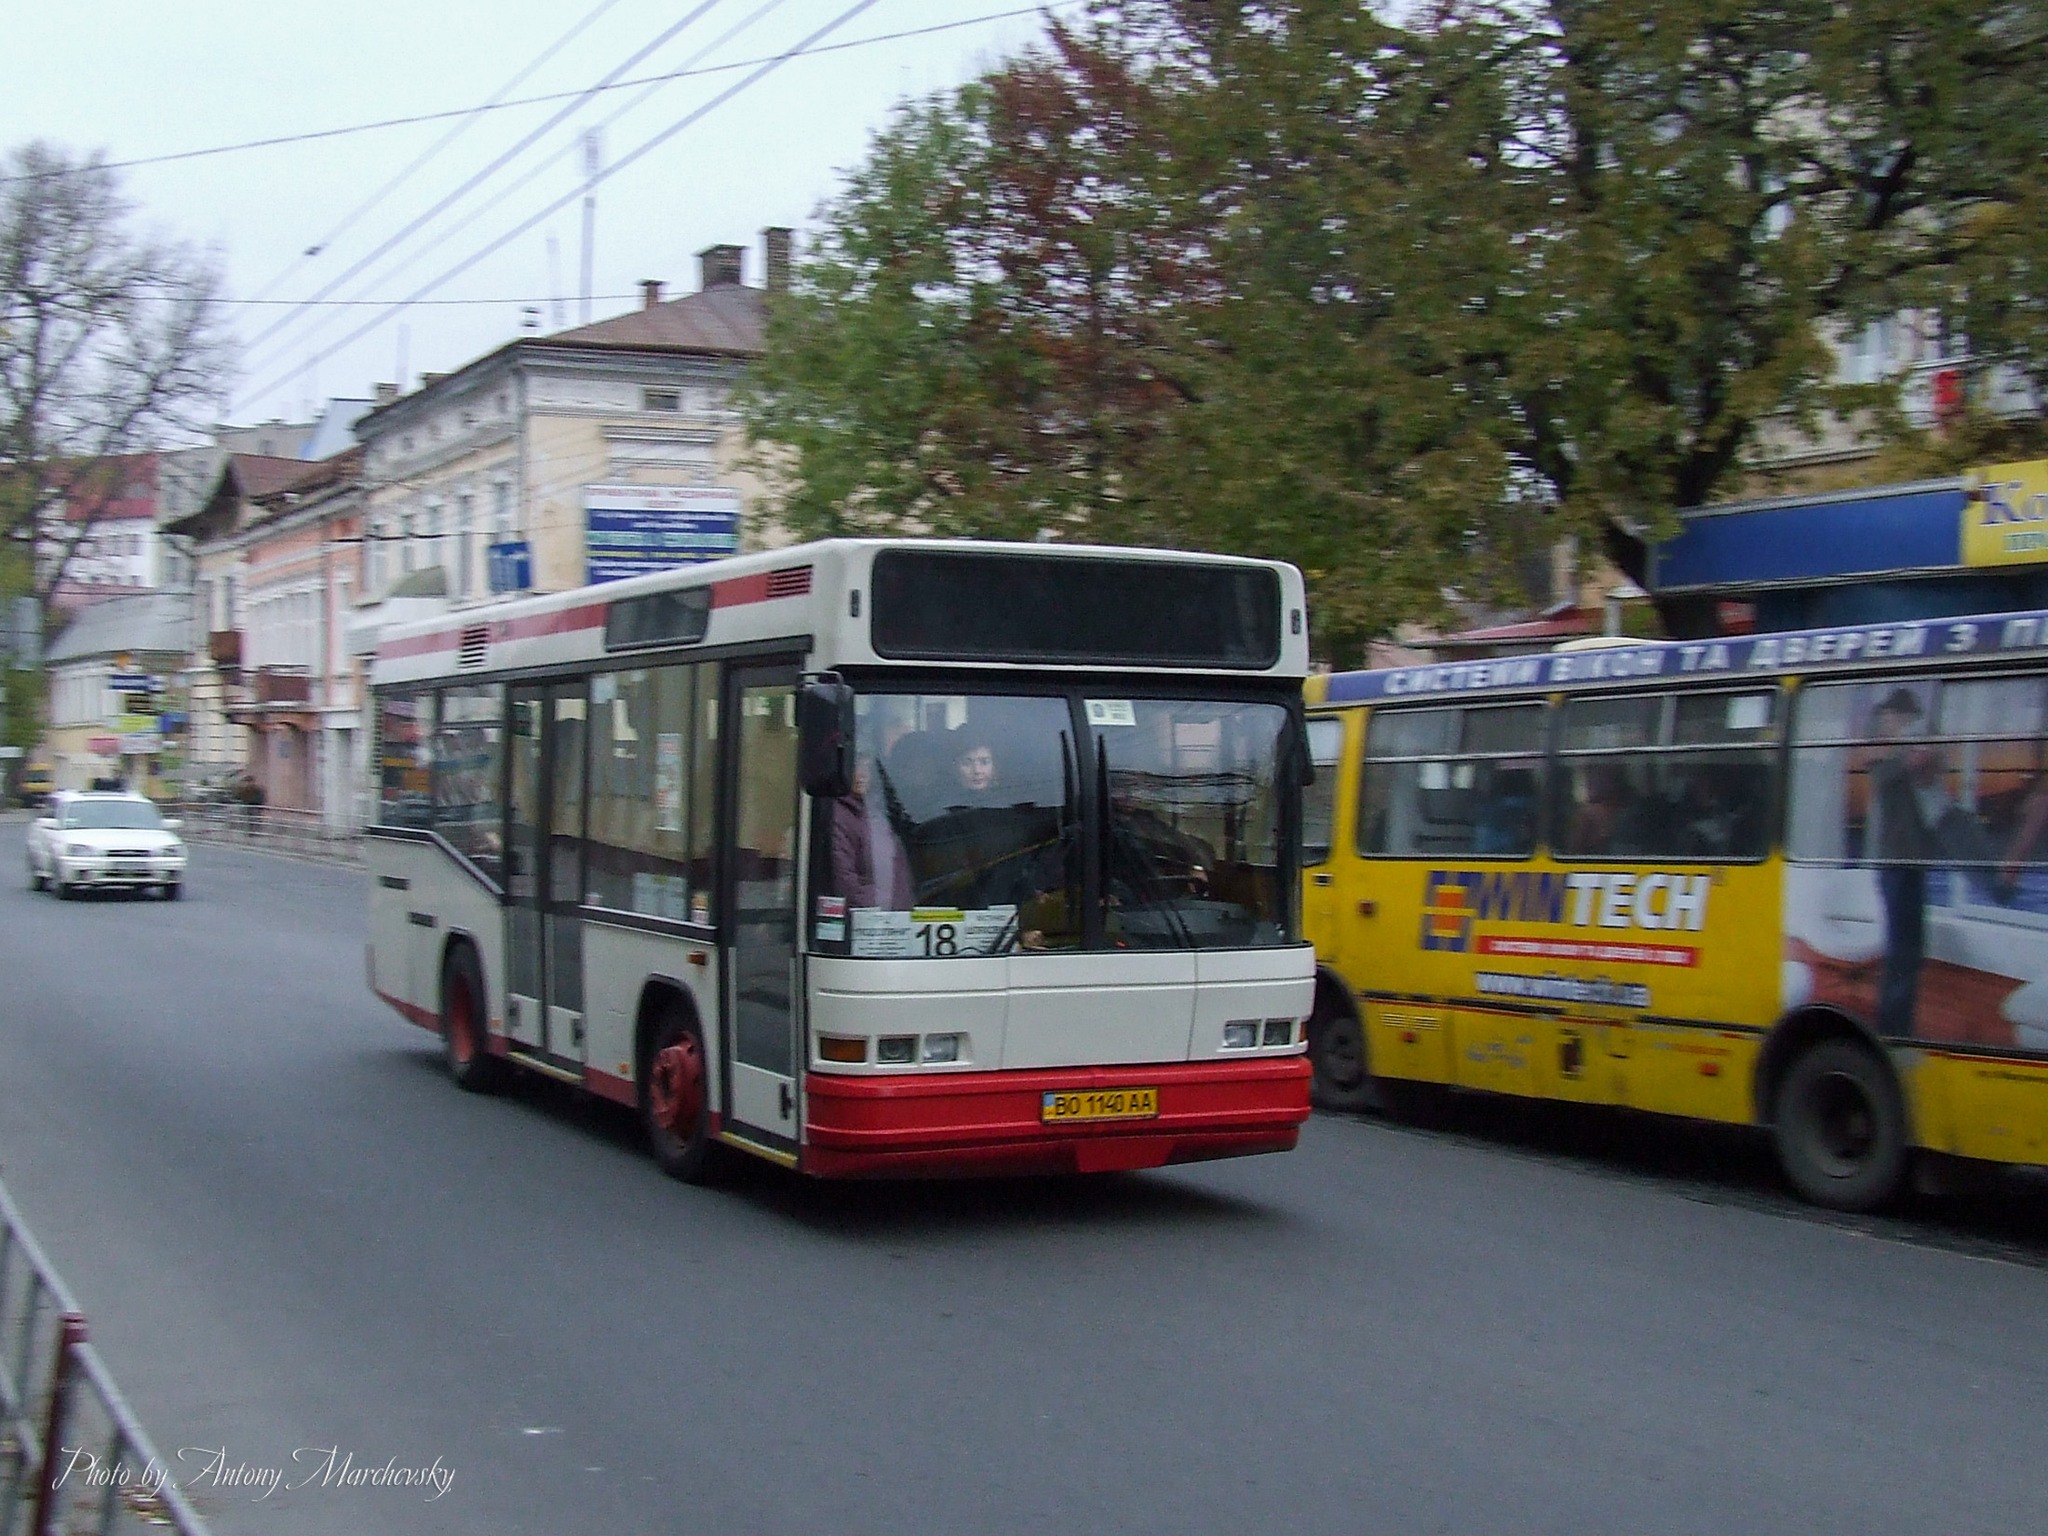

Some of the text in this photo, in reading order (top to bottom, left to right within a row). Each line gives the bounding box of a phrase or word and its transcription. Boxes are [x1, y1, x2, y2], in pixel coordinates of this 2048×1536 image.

[1681, 643, 1730, 673] ТА
[915, 923, 958, 957] 18
[1086, 1093, 1125, 1115] 1140
